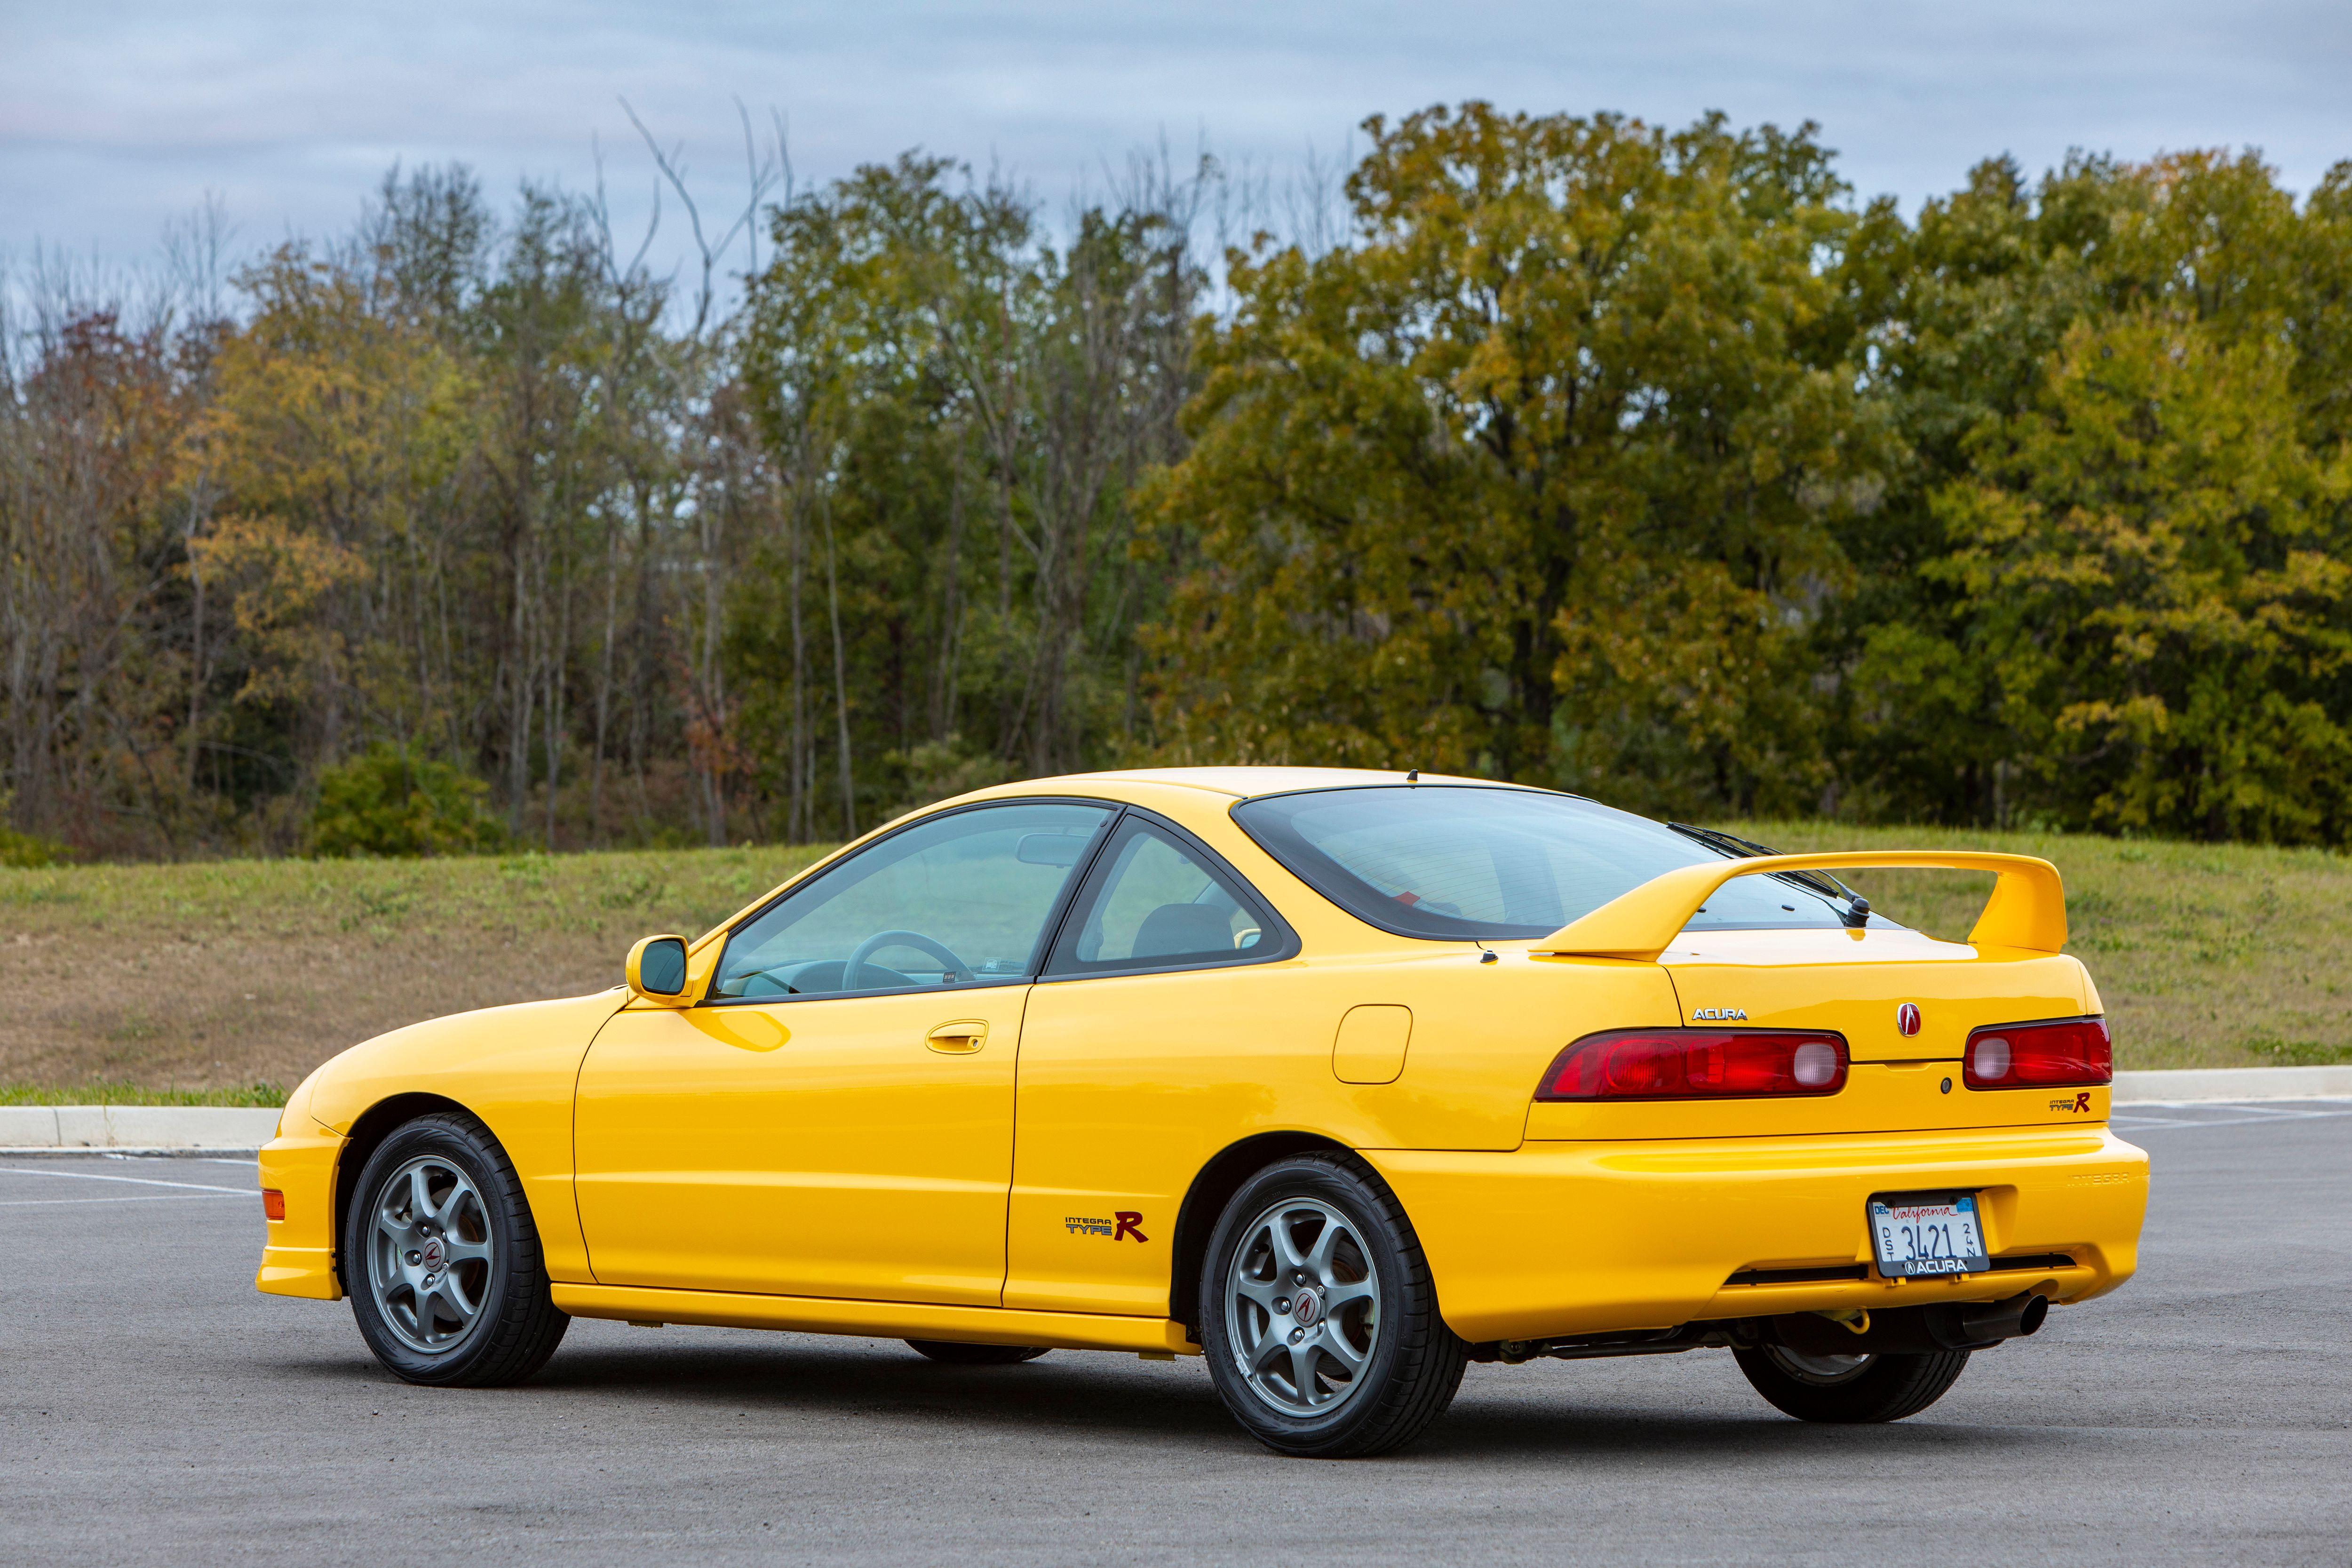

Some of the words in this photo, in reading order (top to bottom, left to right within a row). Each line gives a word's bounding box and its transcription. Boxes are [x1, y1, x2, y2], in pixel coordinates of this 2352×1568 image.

[1692, 1008, 1748, 1020] ACURA
[2073, 1092, 2090, 1113] R
[1875, 1205, 1890, 1215] DEC
[1892, 1206, 1958, 1224] California
[1065, 1217, 1112, 1225] INTEGRA
[1065, 1224, 1112, 1235] TYPE
[1113, 1211, 1149, 1243] R
[1901, 1223, 1957, 1260] 3421
[1916, 1259, 1969, 1274] ACURA
